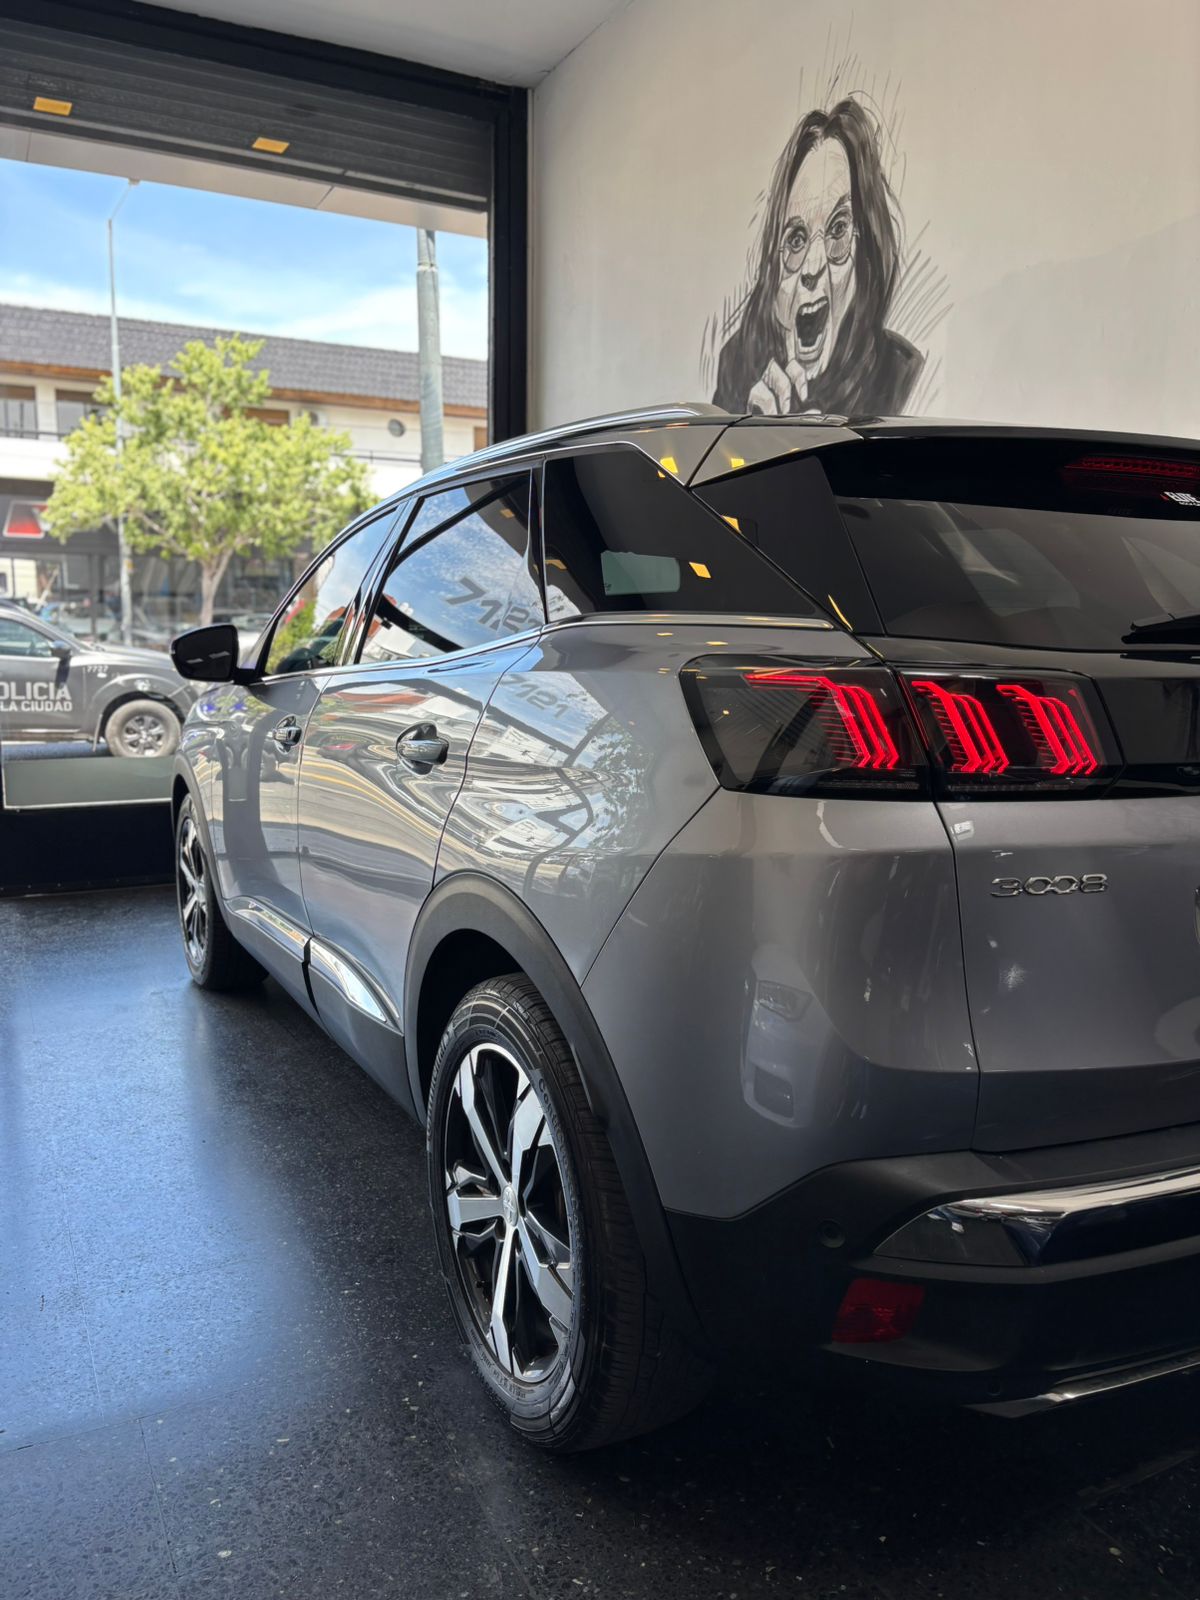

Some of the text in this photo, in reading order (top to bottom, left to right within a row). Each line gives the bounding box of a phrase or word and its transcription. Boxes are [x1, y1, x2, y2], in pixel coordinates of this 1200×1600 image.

[0, 700, 73, 712] LA CIUDAD
[990, 873, 1109, 897] 3008
